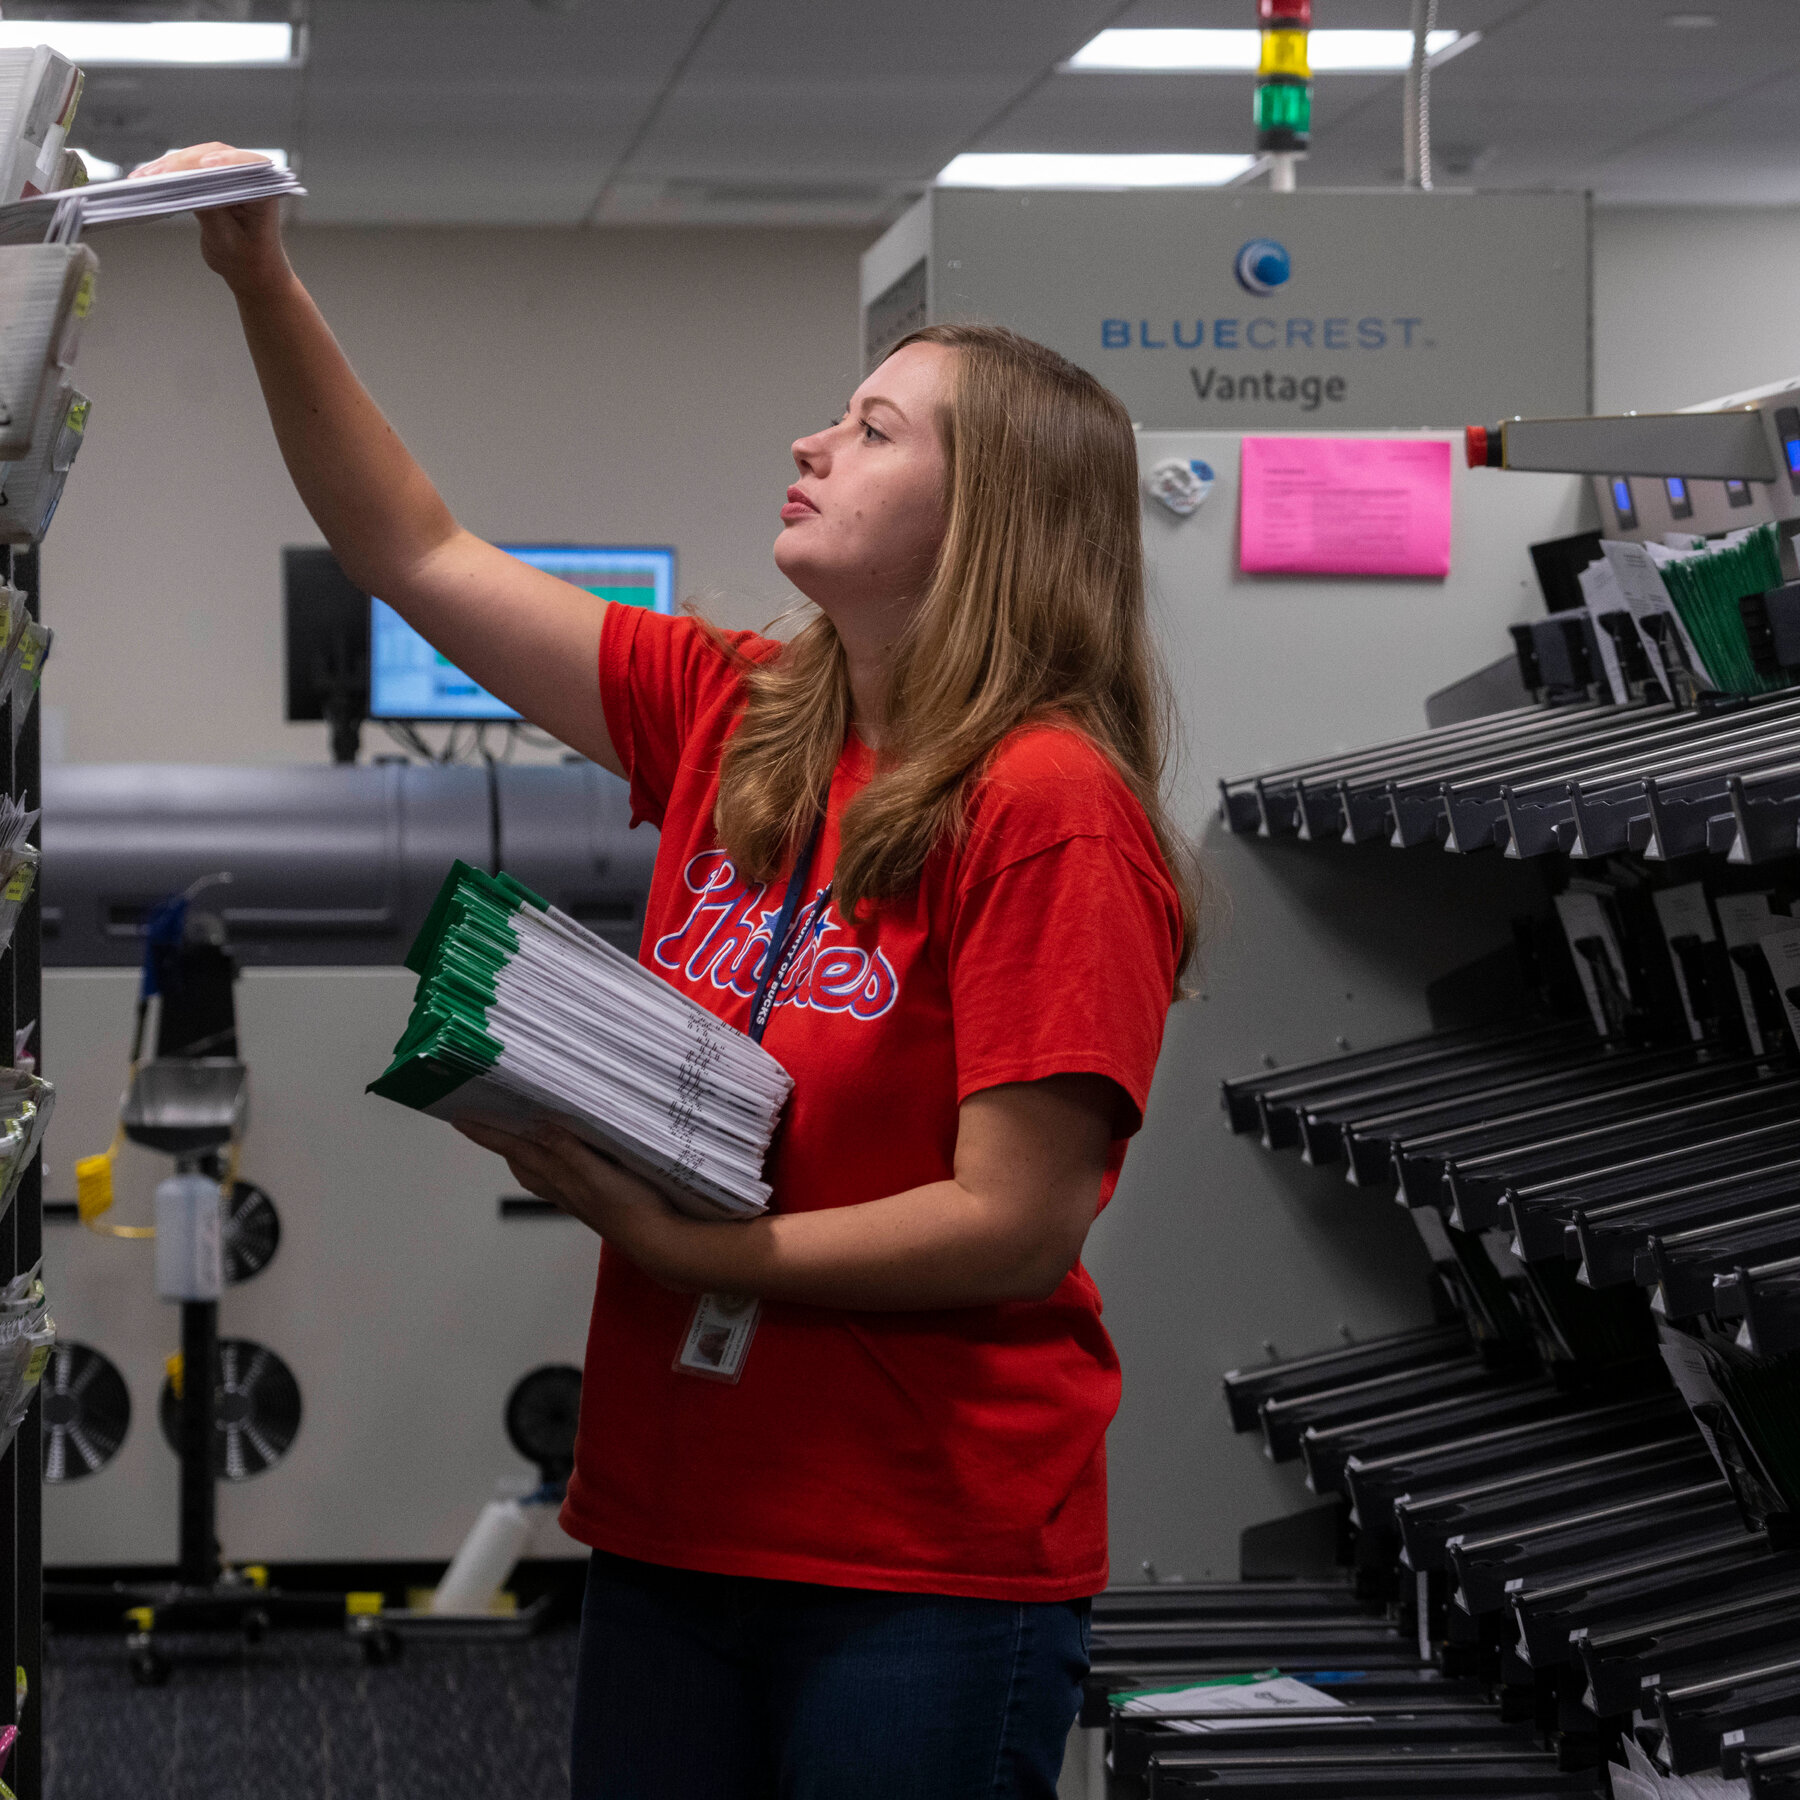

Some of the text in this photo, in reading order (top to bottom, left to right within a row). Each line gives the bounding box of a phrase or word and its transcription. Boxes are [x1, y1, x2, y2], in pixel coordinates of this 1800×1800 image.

[1101, 317, 1423, 349] BLUECREST
[1190, 366, 1347, 411] Vantage
[755, 909, 816, 1026] COUNTY OF BUCKS
